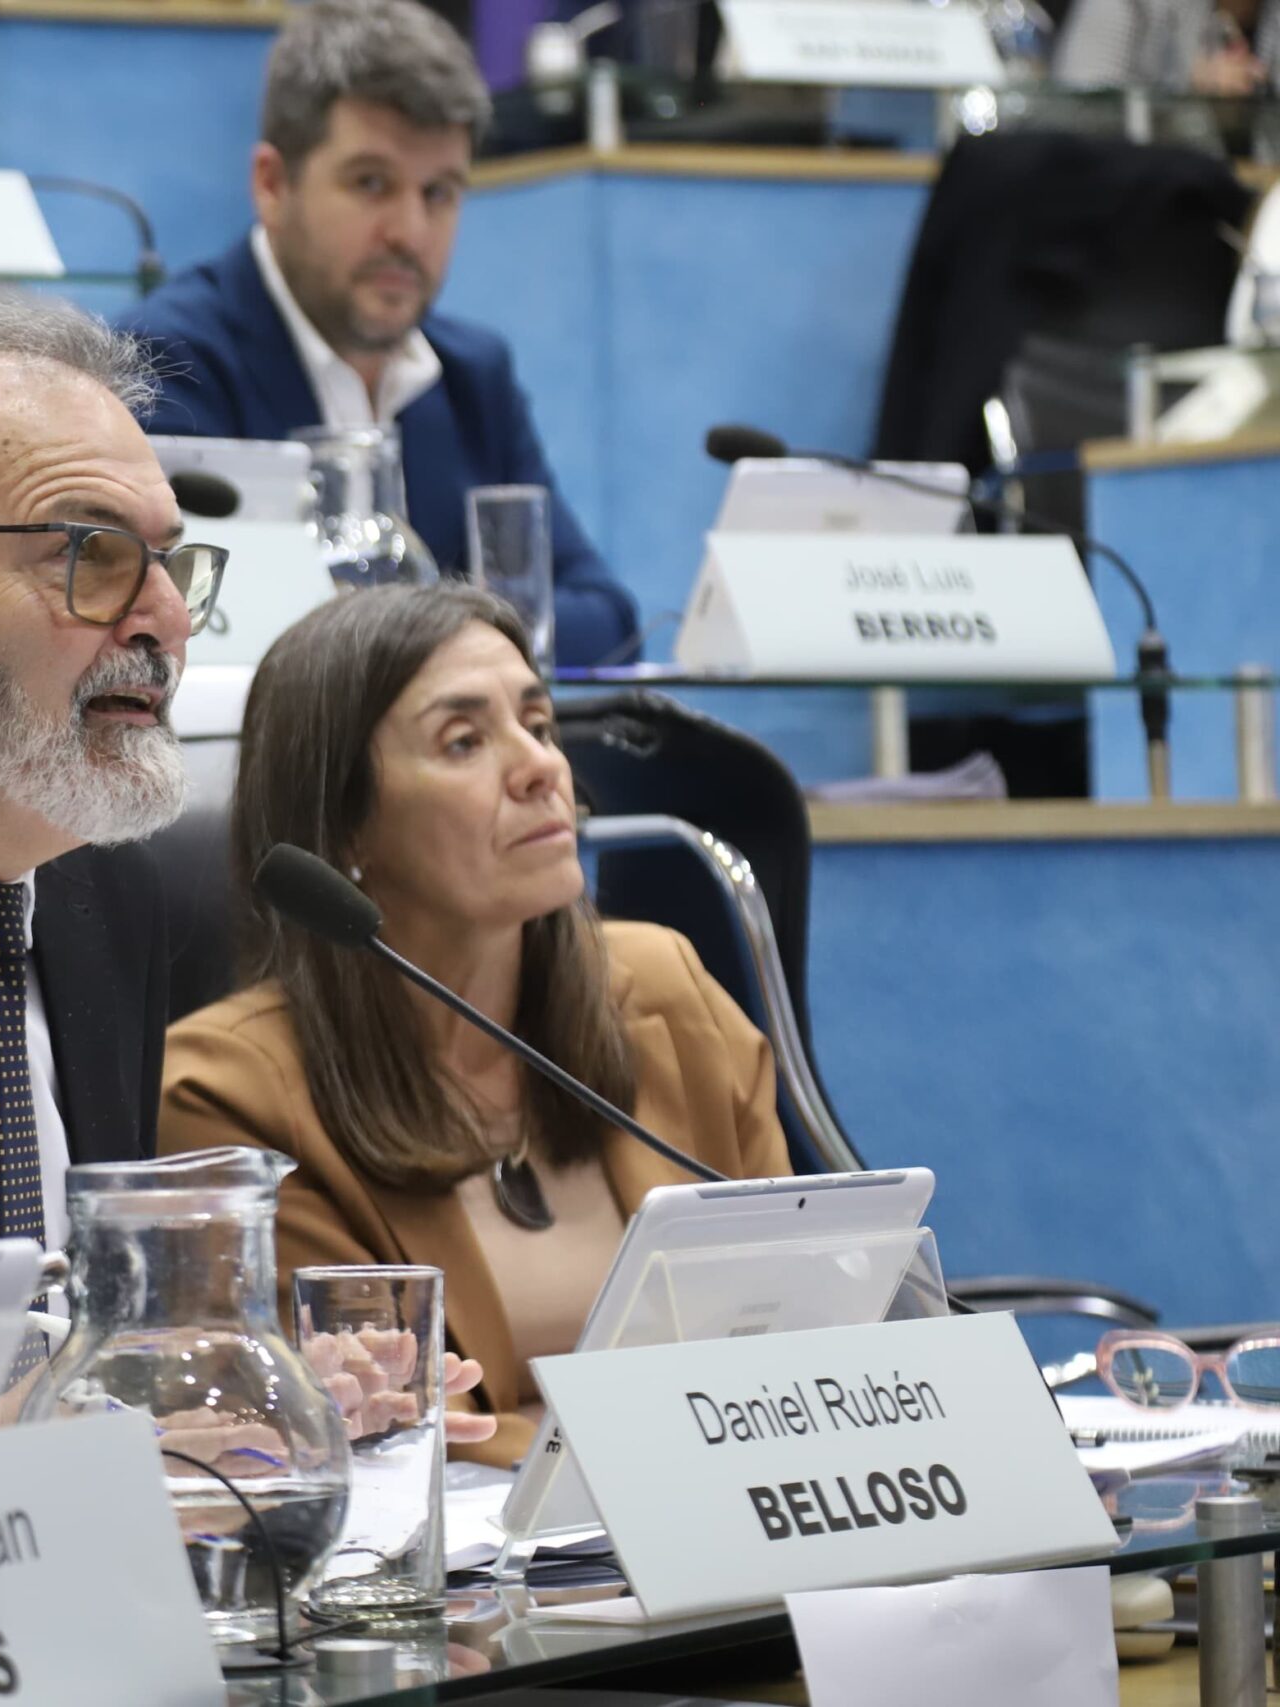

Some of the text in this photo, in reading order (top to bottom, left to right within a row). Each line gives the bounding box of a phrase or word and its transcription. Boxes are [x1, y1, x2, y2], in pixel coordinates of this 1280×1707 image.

[846, 559, 974, 592] José Luis
[853, 611, 998, 643] BERROS
[685, 1370, 946, 1445] Daniel Rubén
[746, 1464, 968, 1541] BELLOSO
